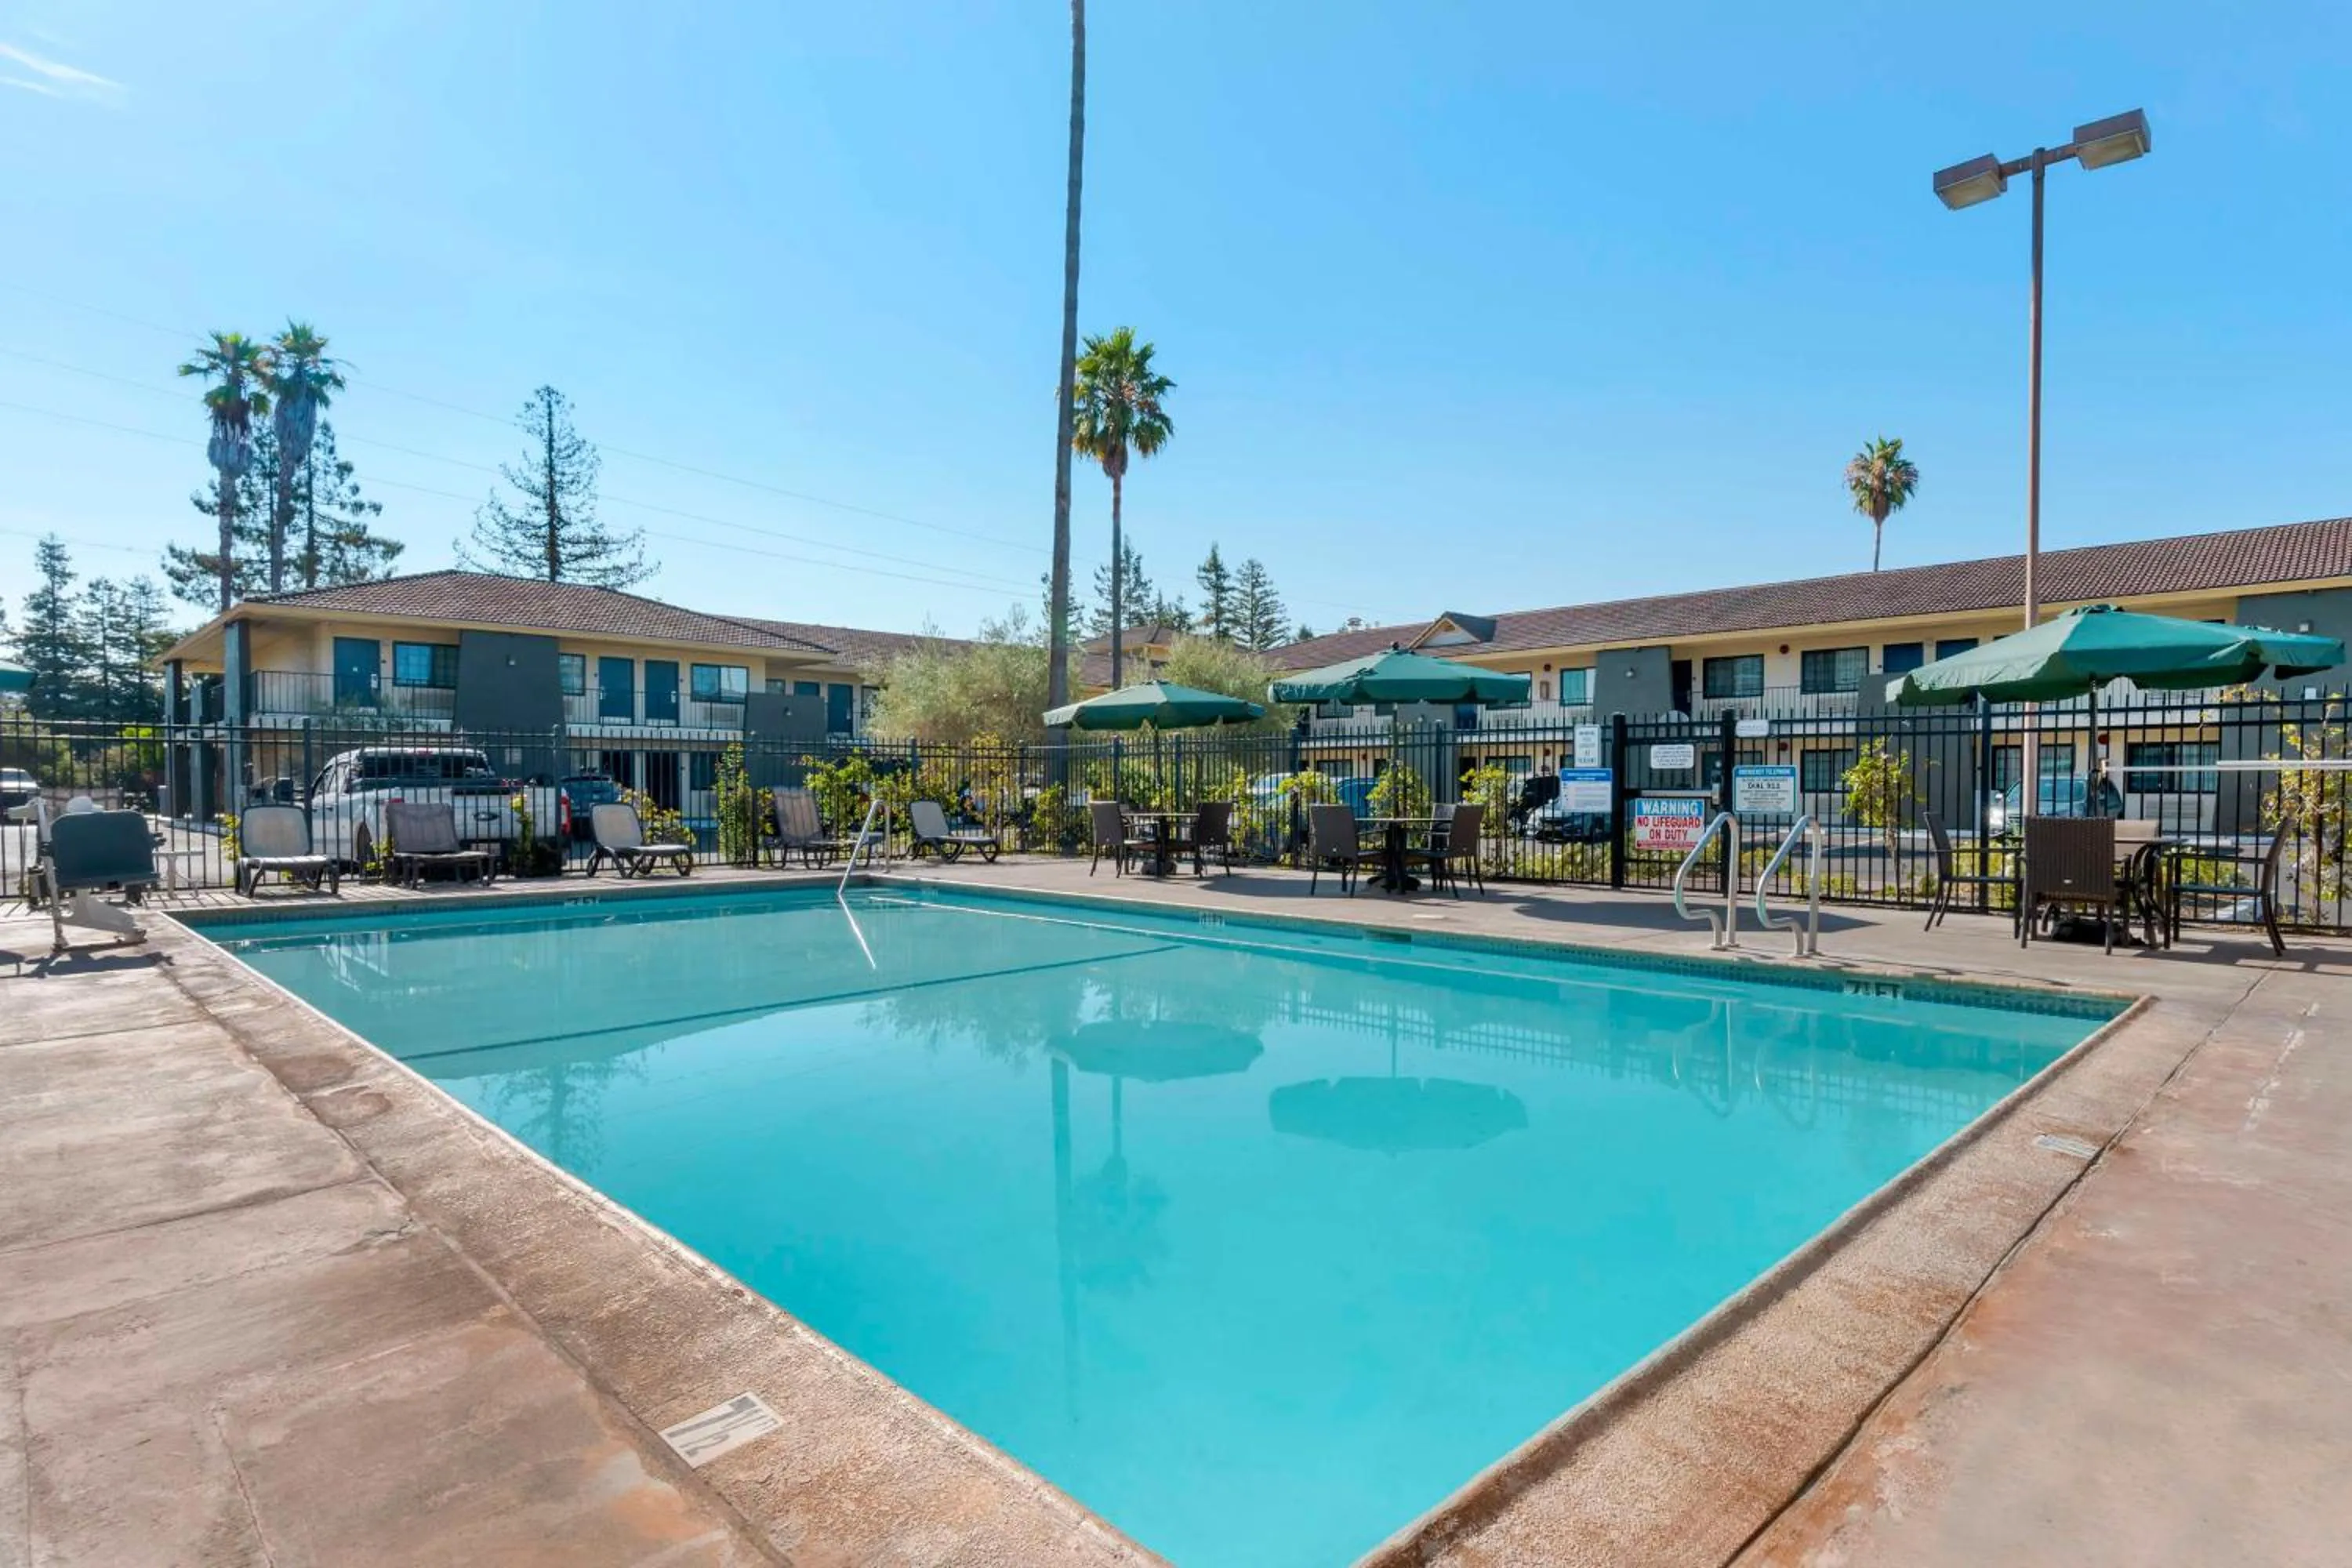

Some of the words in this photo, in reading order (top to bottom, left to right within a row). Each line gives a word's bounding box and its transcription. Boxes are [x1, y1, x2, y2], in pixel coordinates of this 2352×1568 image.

[1642, 800, 1699, 815] WARNING
[1637, 816, 1650, 827] NO
[1652, 816, 1700, 828] LIFEGUARD
[1649, 829, 1661, 840] ON
[1664, 829, 1688, 840] DUTY
